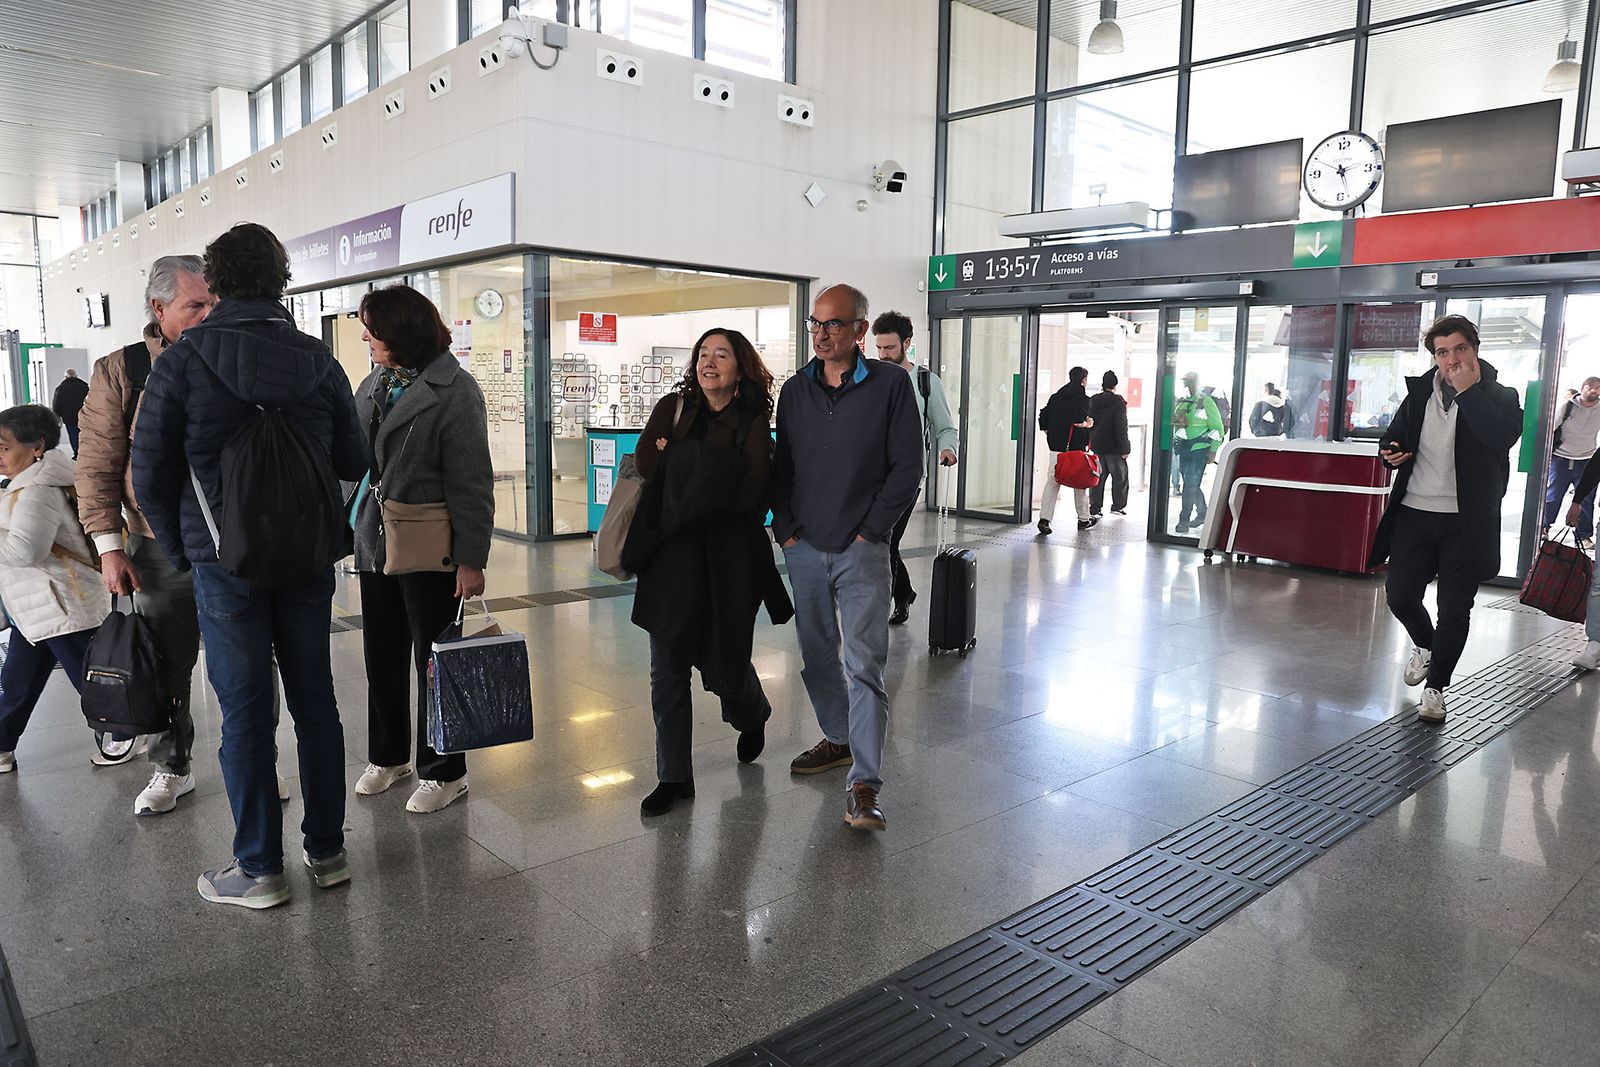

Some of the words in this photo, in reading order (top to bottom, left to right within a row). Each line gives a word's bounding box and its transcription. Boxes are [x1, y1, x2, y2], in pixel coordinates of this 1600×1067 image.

[1338, 140, 1351, 151] 12
[1364, 163, 1373, 173] 3
[1313, 170, 1321, 179] 9
[1336, 192, 1345, 202] 6
[428, 198, 473, 240] renfe
[353, 223, 392, 247] Información
[1051, 251, 1084, 264] Acceso
[1087, 253, 1094, 261] a
[1097, 248, 1119, 260] vías
[1050, 267, 1084, 275] PLATFORMS
[565, 382, 595, 396] renfe
[501, 403, 518, 415] renfe
